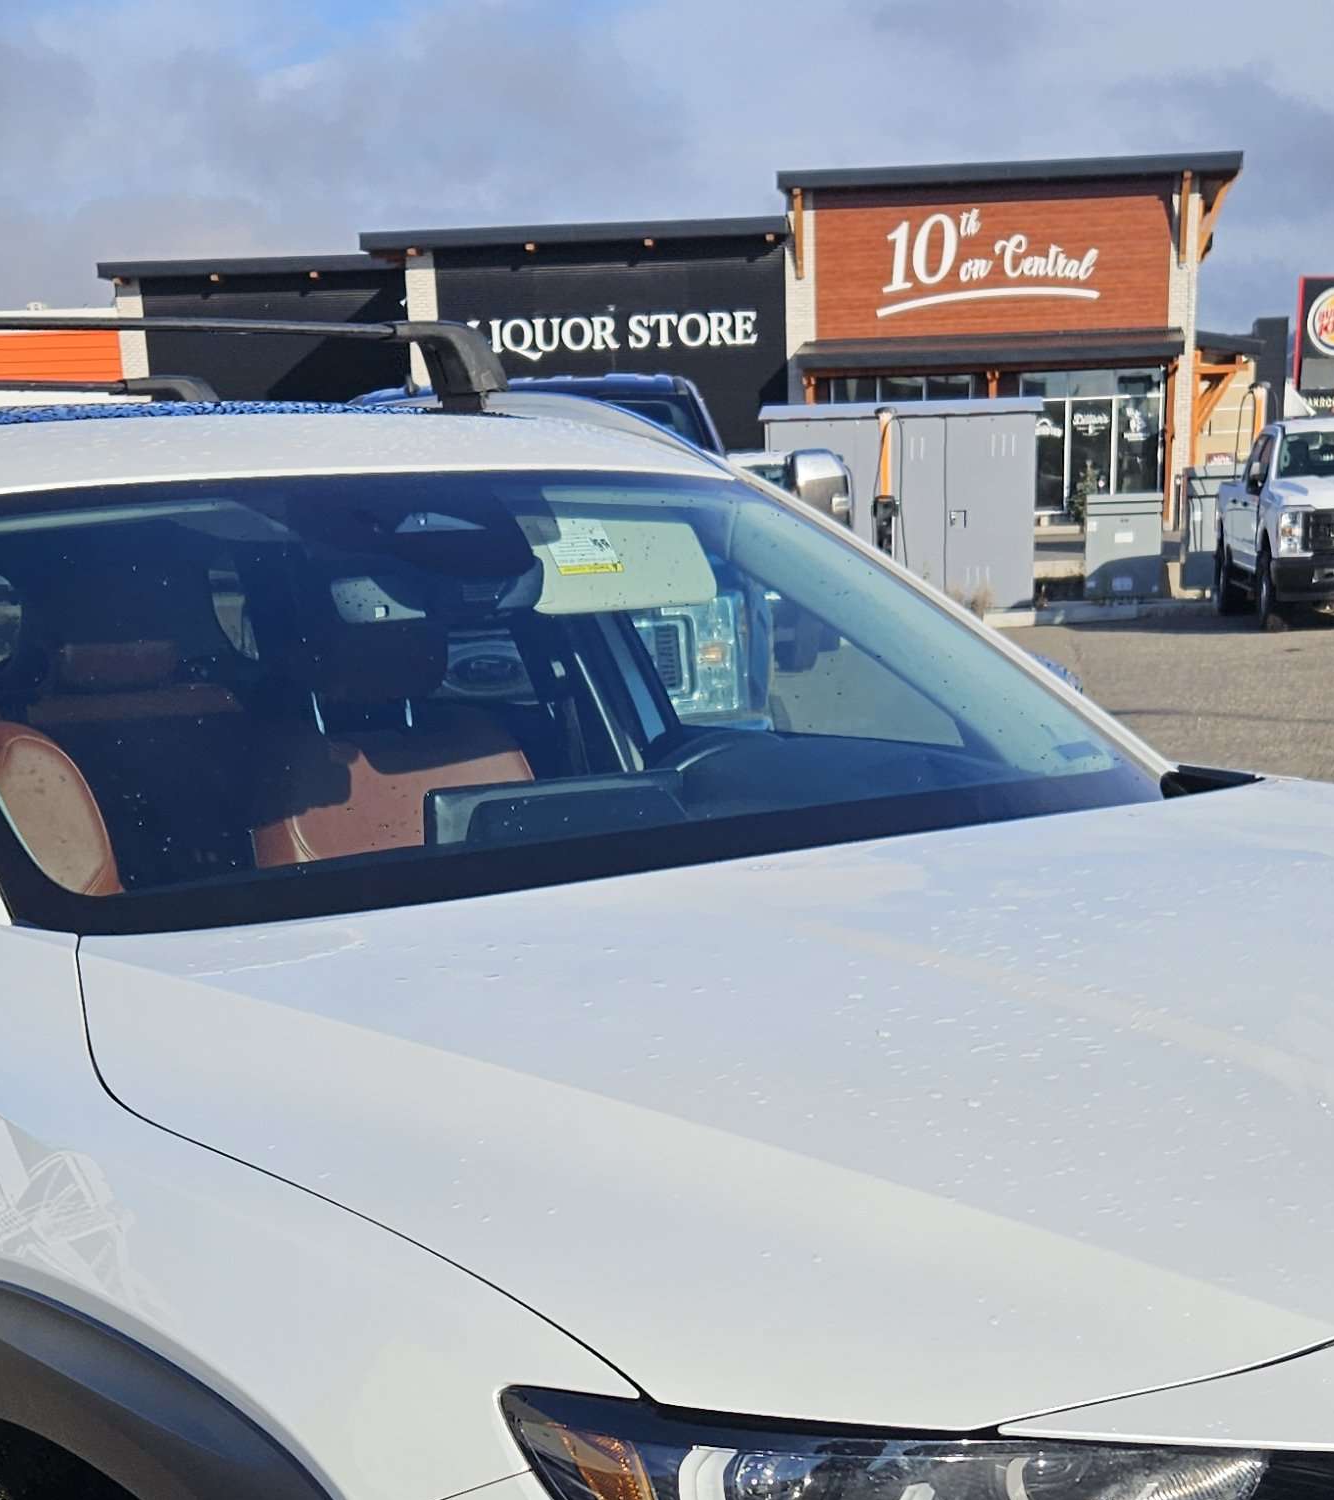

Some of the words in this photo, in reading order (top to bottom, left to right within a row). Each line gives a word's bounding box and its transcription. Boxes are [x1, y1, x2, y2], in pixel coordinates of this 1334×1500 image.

[958, 258, 994, 282] on
[994, 233, 1100, 281] Central
[467, 315, 621, 361] IQUOR
[627, 310, 758, 348] STORE
